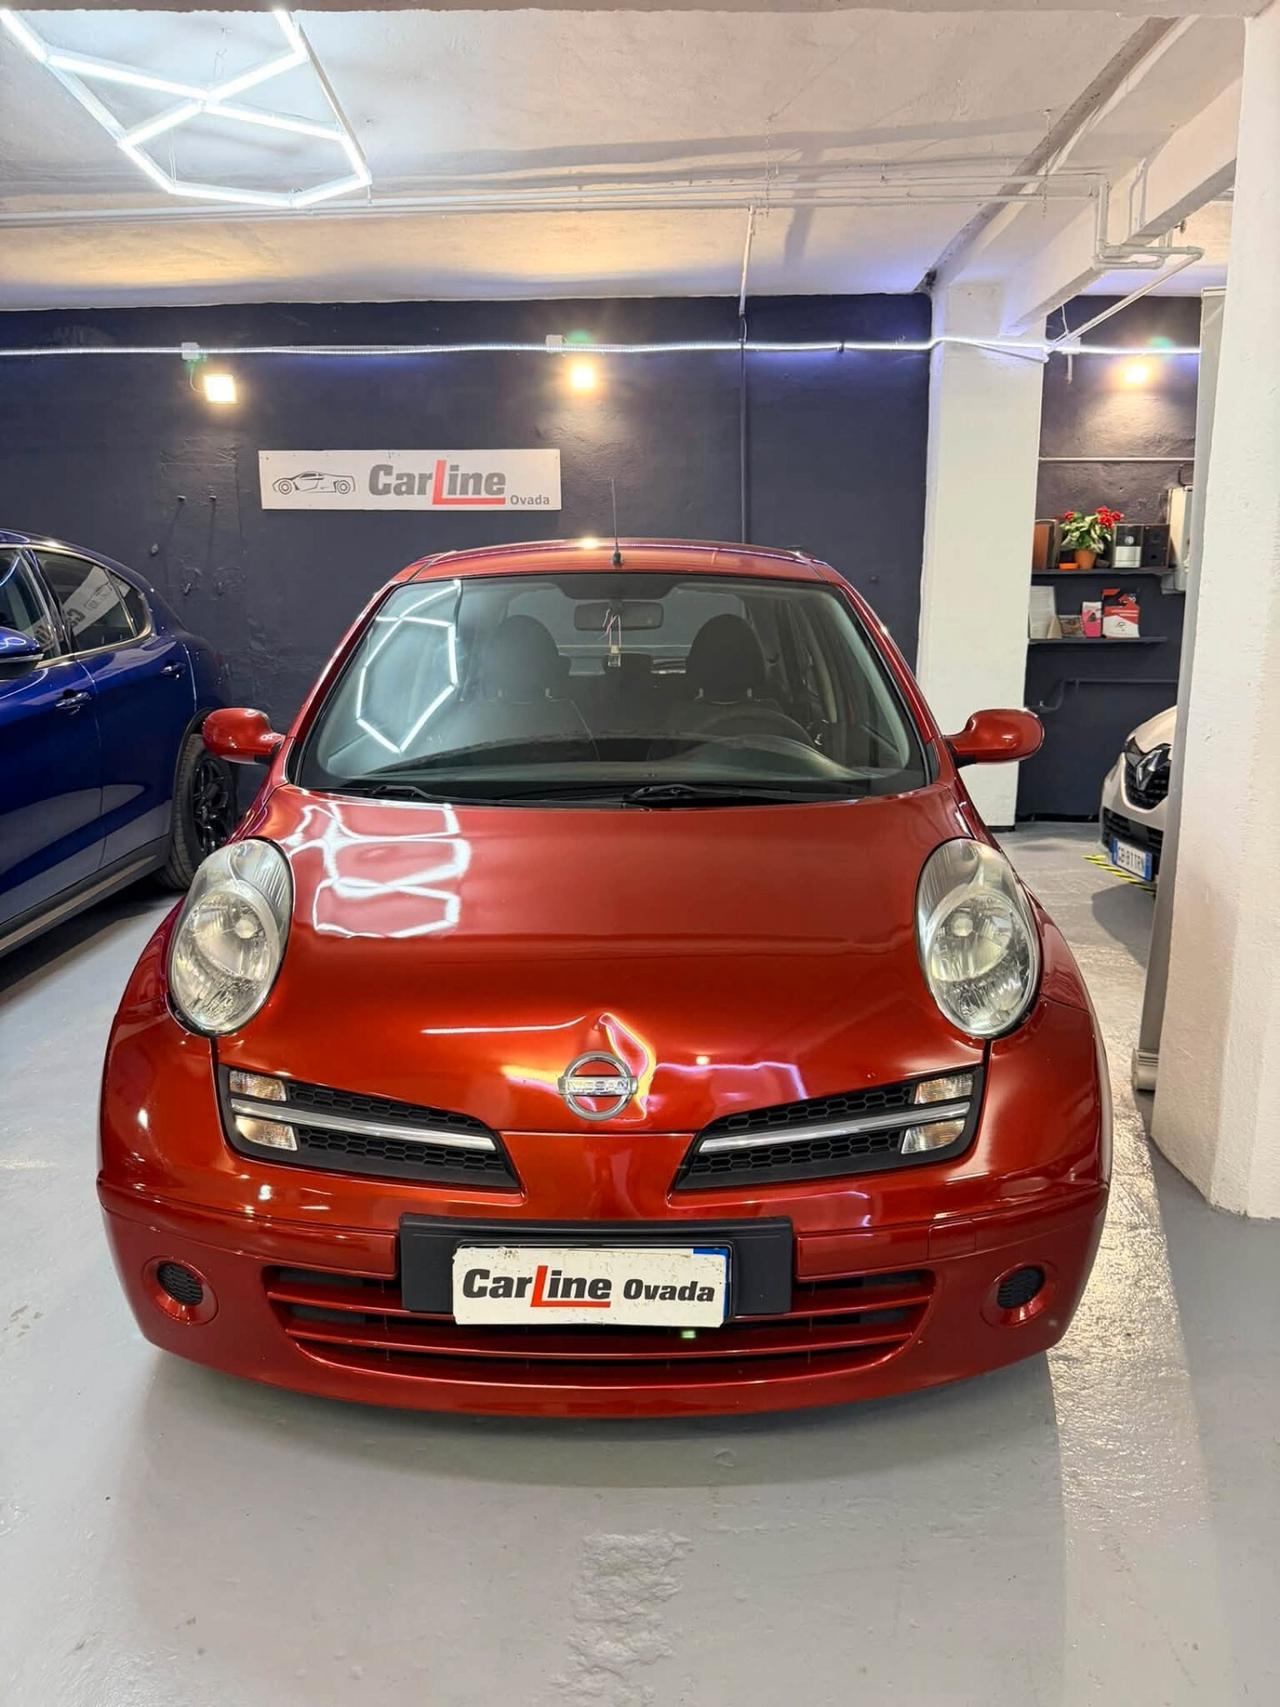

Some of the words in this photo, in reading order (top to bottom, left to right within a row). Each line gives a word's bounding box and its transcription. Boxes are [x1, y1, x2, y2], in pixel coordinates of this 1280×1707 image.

[368, 459, 506, 505] CarLine
[510, 494, 550, 505] Ovada
[568, 1080, 629, 1092] NISSAN
[463, 1265, 612, 1307] CarLine
[622, 1278, 715, 1301] Ovada
